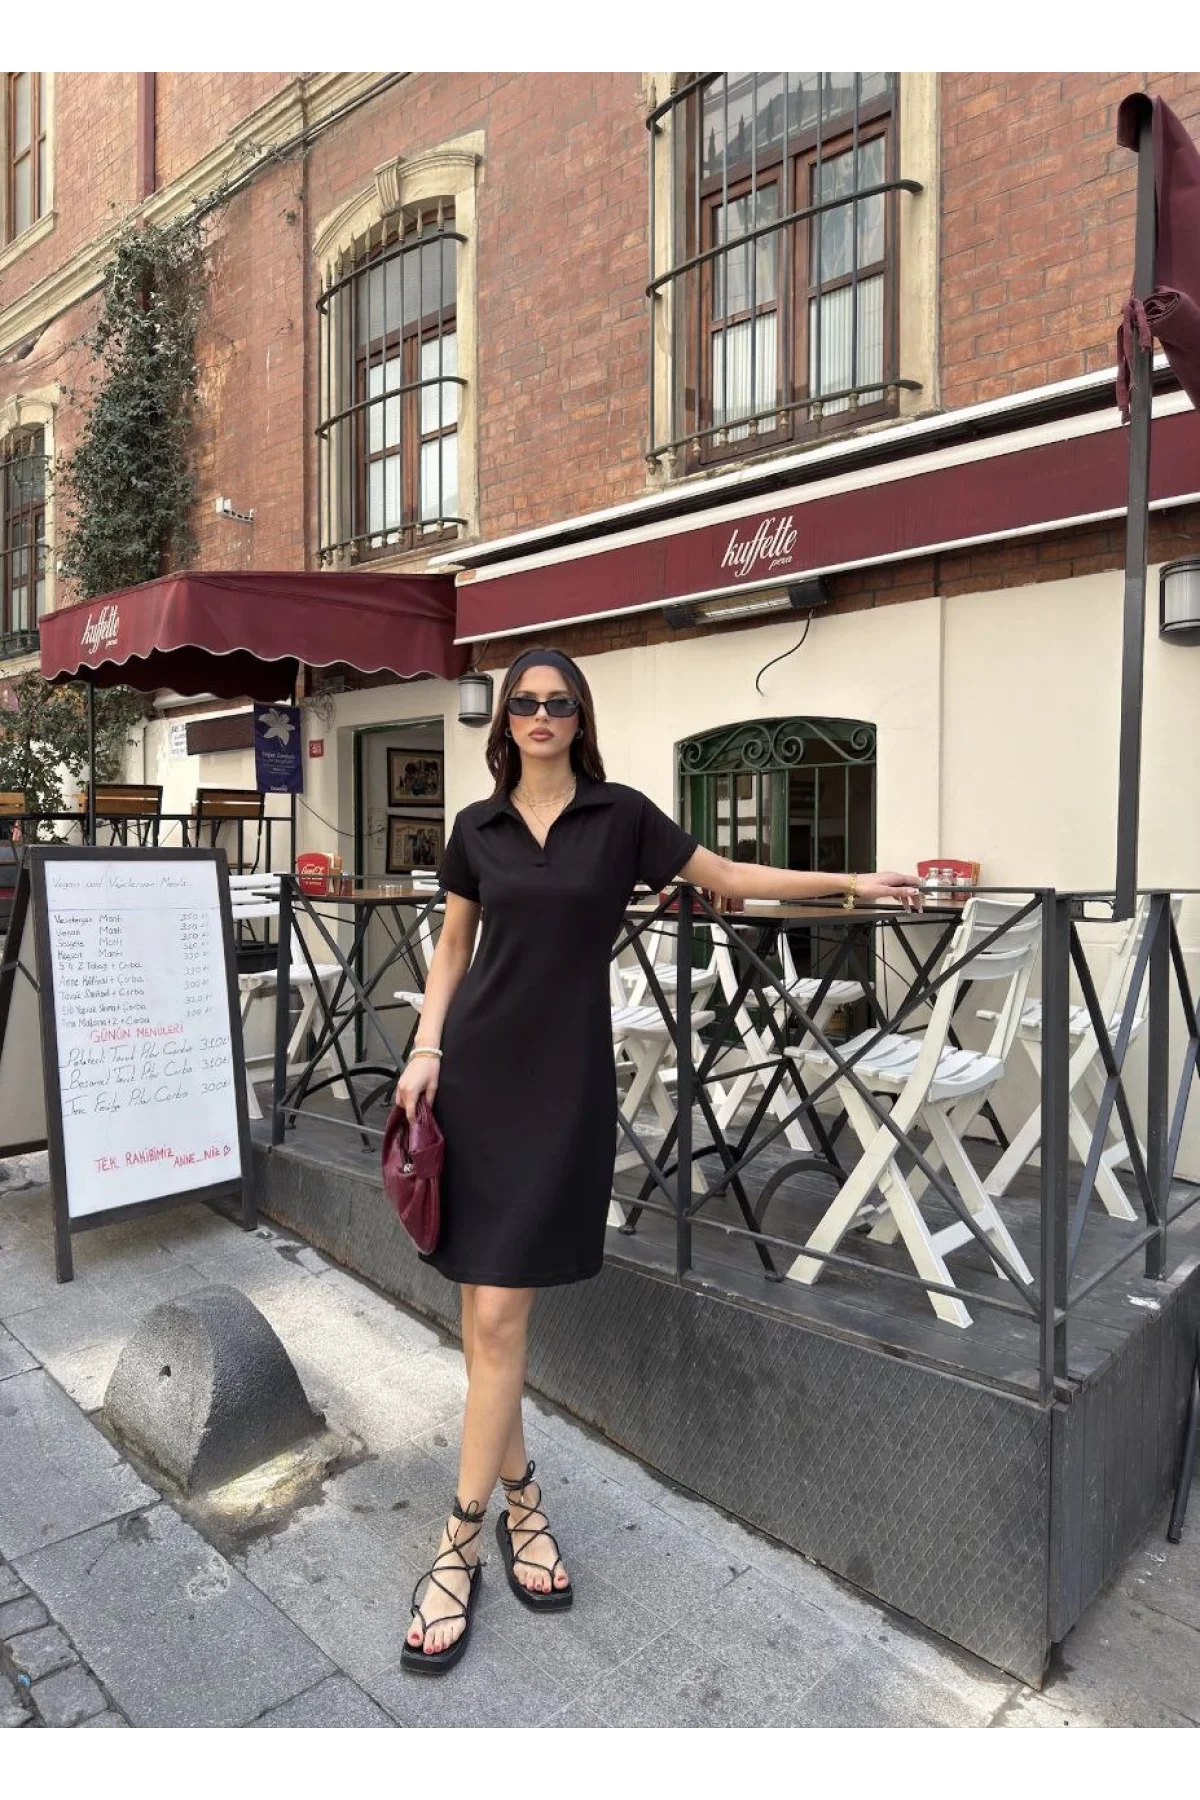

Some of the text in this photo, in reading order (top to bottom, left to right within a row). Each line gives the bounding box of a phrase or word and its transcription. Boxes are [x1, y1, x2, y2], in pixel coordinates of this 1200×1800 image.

[720, 515, 798, 578] kuffette
[768, 555, 793, 571] pera
[80, 604, 120, 655] kuffette
[93, 1156, 120, 1173] TEK
